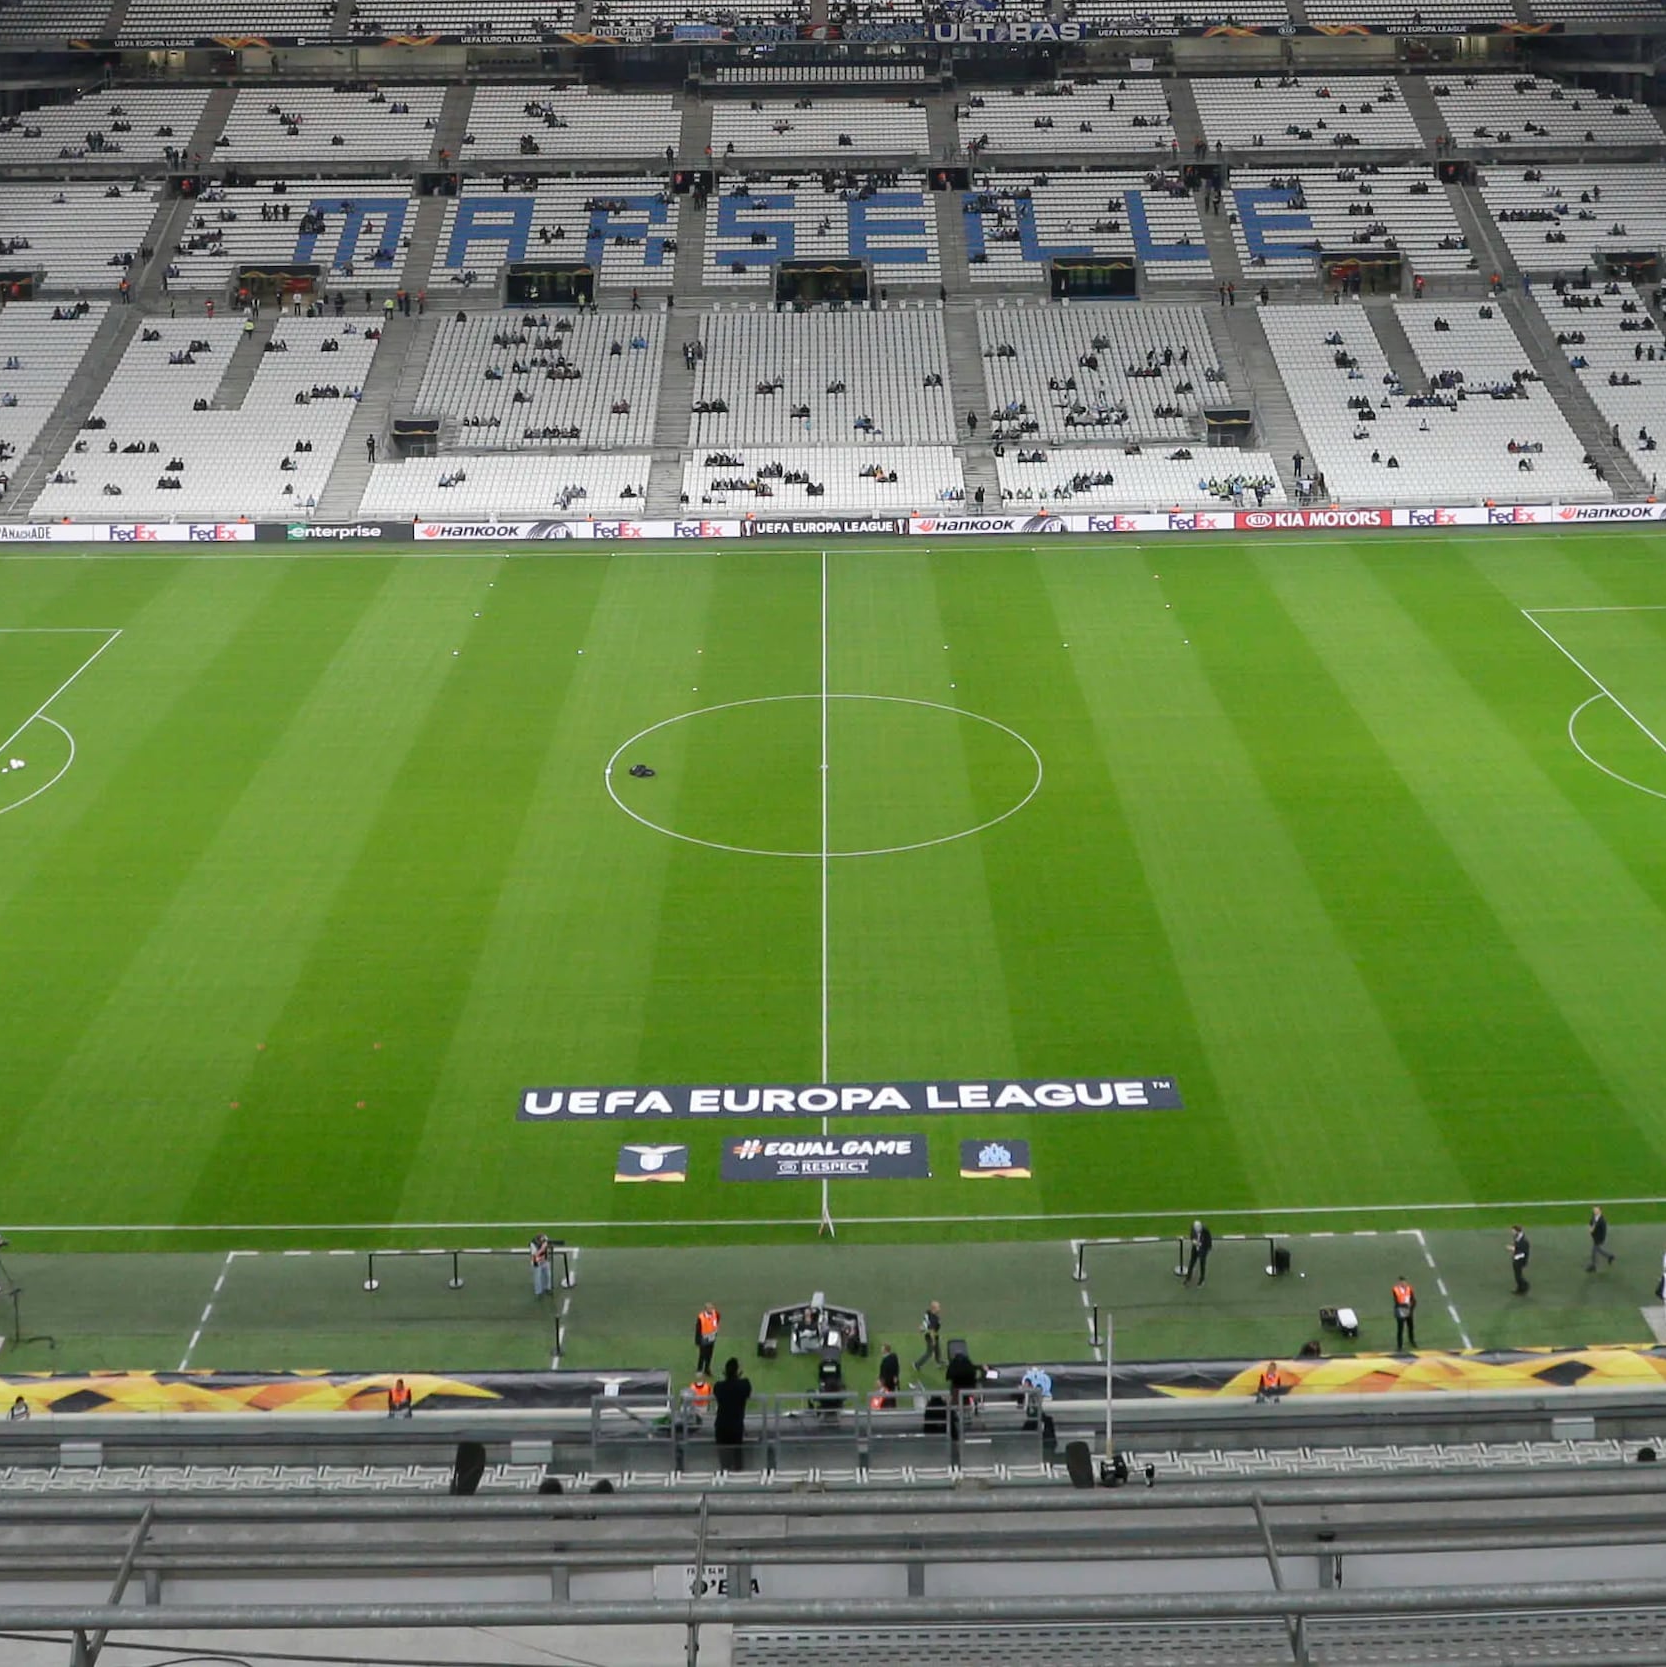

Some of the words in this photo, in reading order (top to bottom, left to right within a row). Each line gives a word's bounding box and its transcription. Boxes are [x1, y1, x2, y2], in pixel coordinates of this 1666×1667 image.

[1150, 28, 1180, 36] LEAGUE
[1408, 25, 1437, 33] EUROPA
[460, 36, 482, 44] UEFA
[482, 35, 512, 43] EUROPA
[513, 35, 542, 43] LEAGUE
[1088, 515, 1136, 532] FedEx
[1169, 513, 1217, 530] FedEx
[1248, 515, 1270, 525] KIA
[1275, 512, 1306, 527] KIA
[1308, 510, 1381, 527] MOTORS
[1409, 509, 1457, 526] FedEx
[1488, 507, 1536, 524] FedEx
[109, 525, 158, 542] FedEx
[189, 525, 238, 542] FedEx
[291, 524, 382, 540] enterprise
[593, 522, 642, 539] FedEx
[674, 521, 723, 538] FedEx
[756, 521, 790, 534] UEFA
[792, 520, 839, 533] EUROPA
[840, 519, 894, 533] LEAGUE
[524, 1089, 673, 1116] UEFA
[688, 1084, 913, 1115] EUROPA
[925, 1080, 1151, 1111] LEAGUE
[802, 1160, 869, 1174] RESPECT
